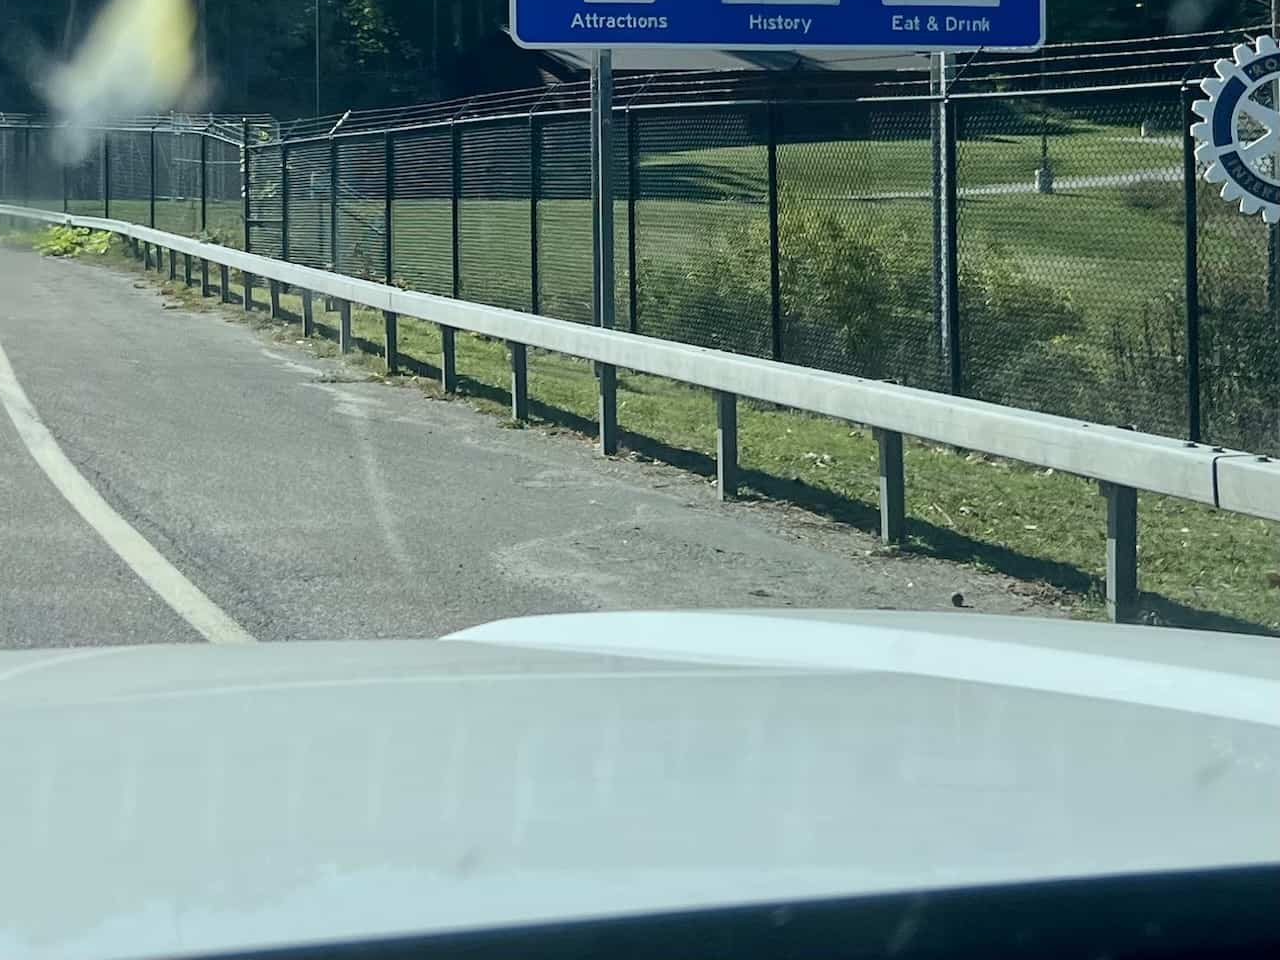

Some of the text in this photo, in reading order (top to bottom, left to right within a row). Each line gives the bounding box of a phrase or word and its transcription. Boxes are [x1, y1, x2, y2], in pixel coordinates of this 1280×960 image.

[570, 12, 669, 30] Attractions
[749, 14, 812, 33] History
[891, 15, 991, 33] Eat & Drink
